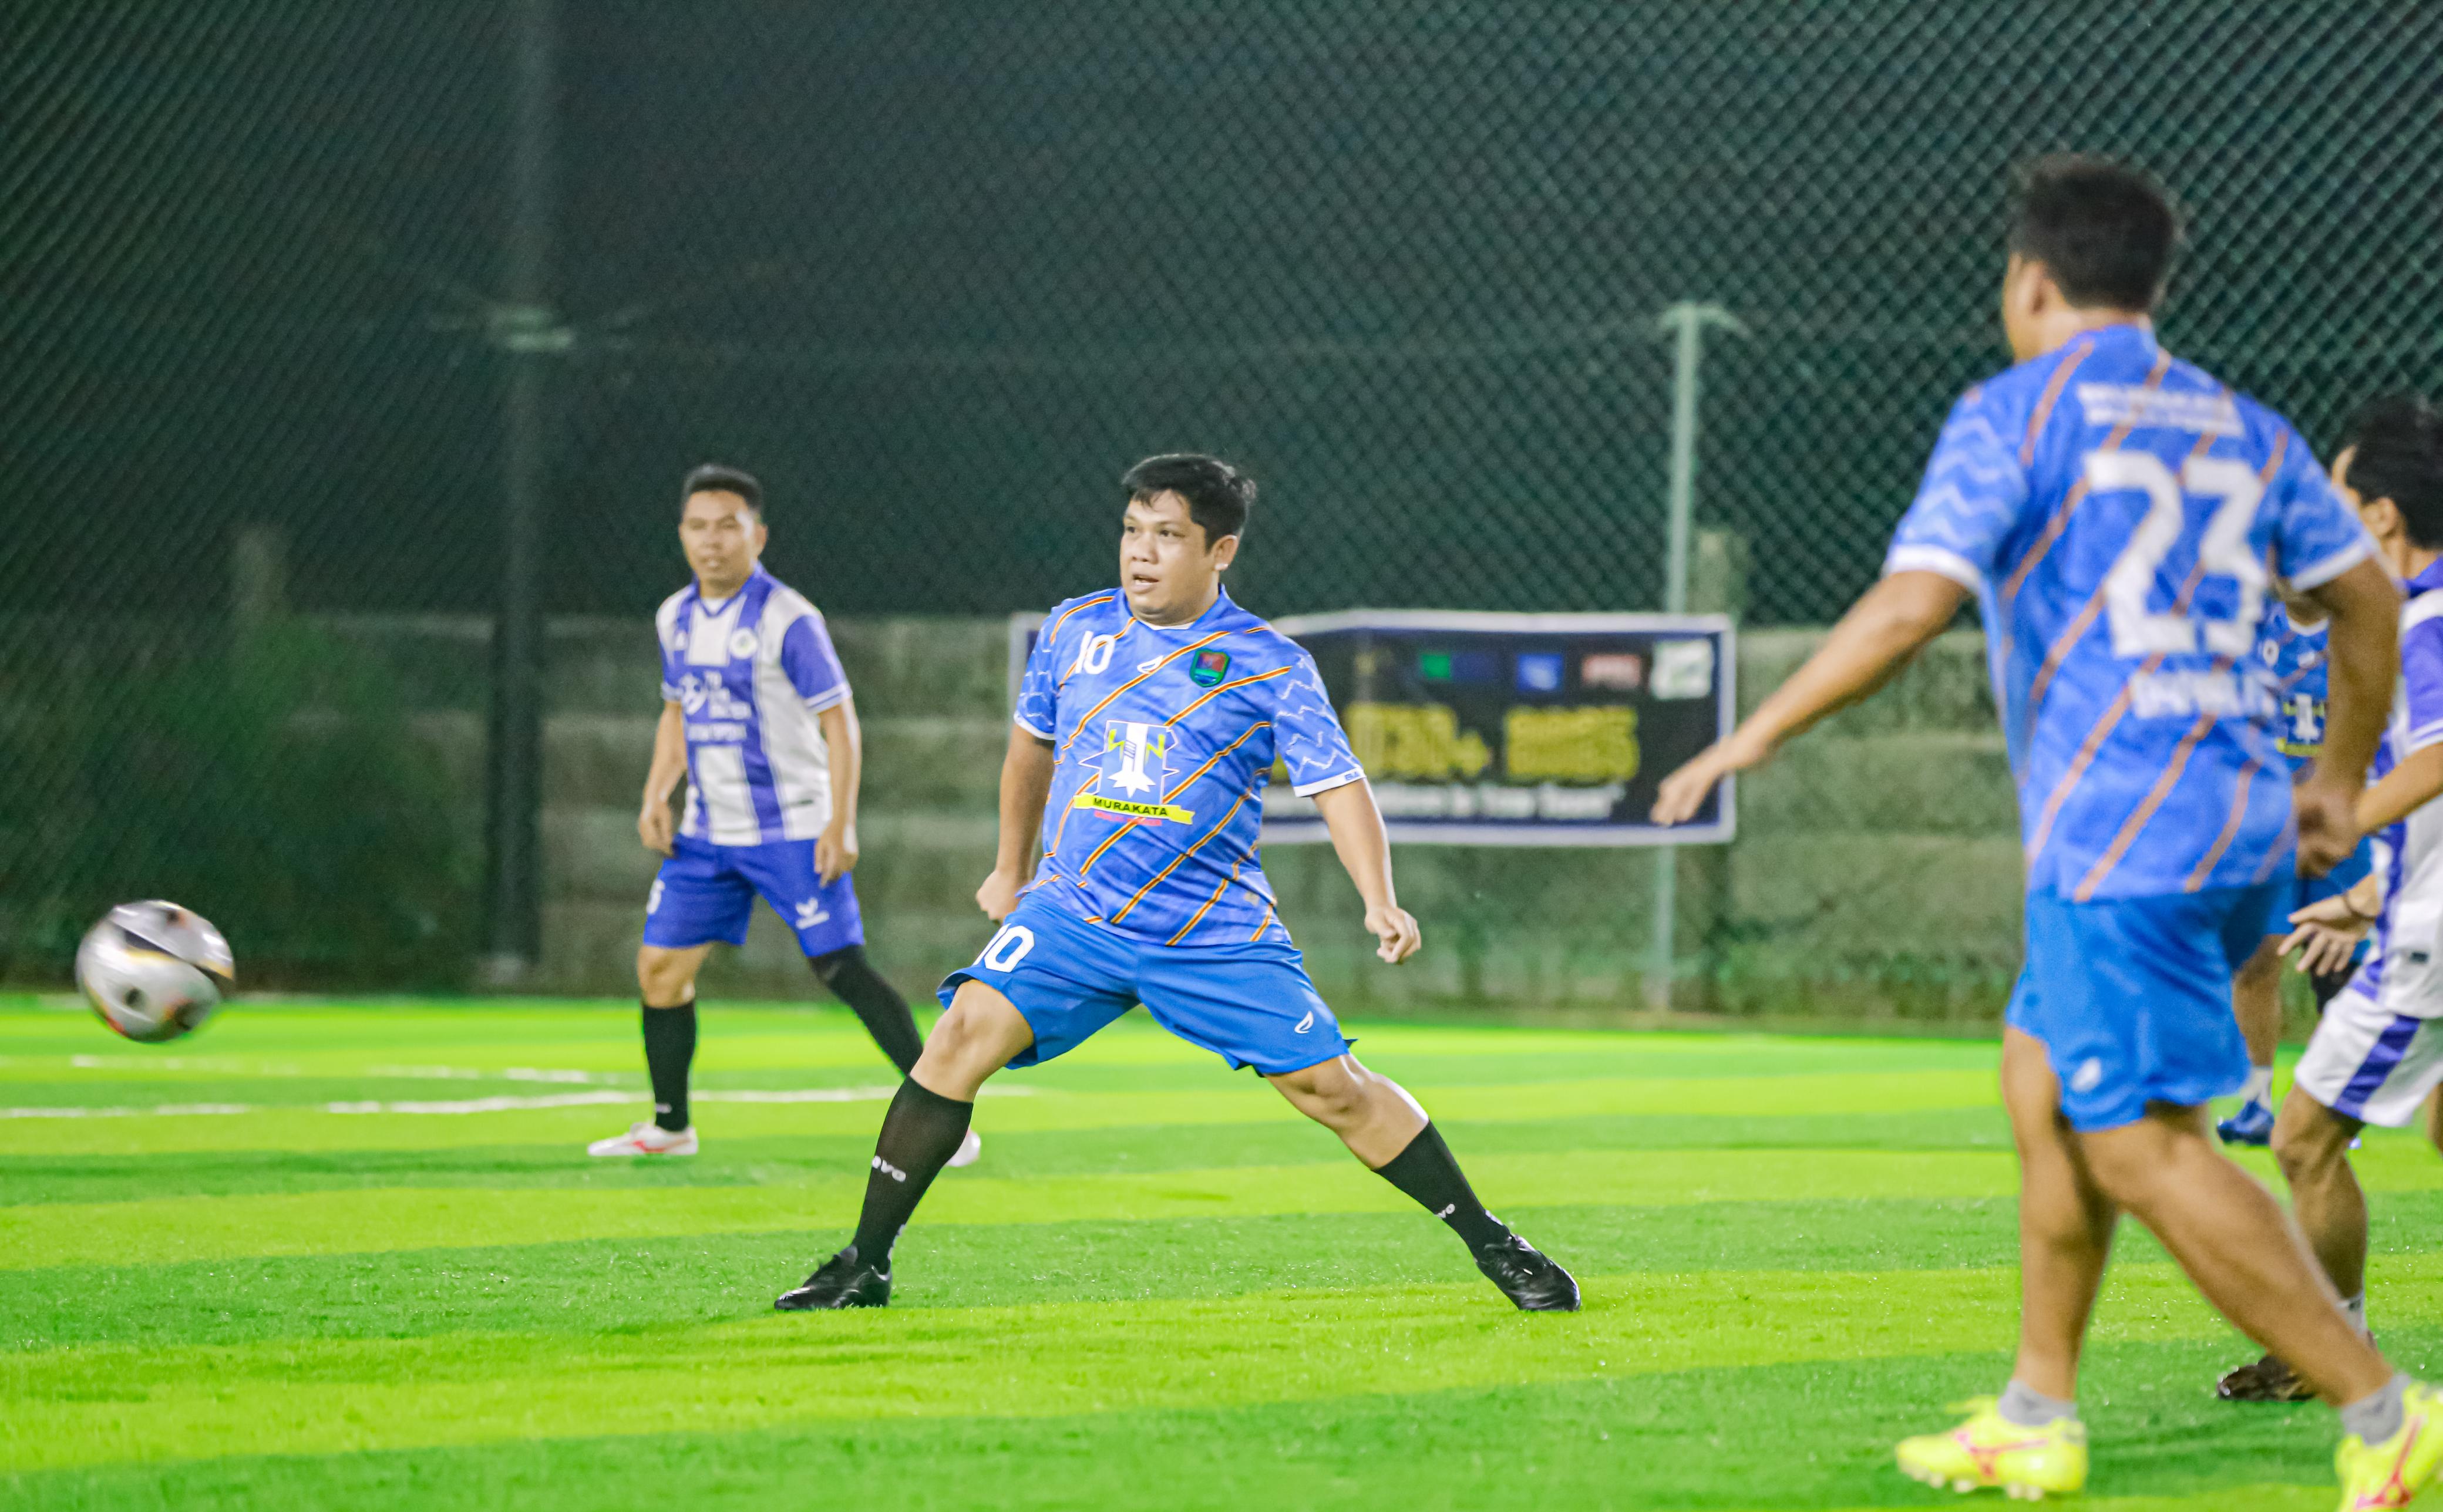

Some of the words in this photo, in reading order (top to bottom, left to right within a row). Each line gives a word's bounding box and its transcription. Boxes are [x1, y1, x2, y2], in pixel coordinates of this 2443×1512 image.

[2083, 450, 2266, 656] 23
[1075, 631, 1115, 675] 10
[1093, 797, 1167, 816] MURAKATA
[973, 922, 1035, 973] 10
